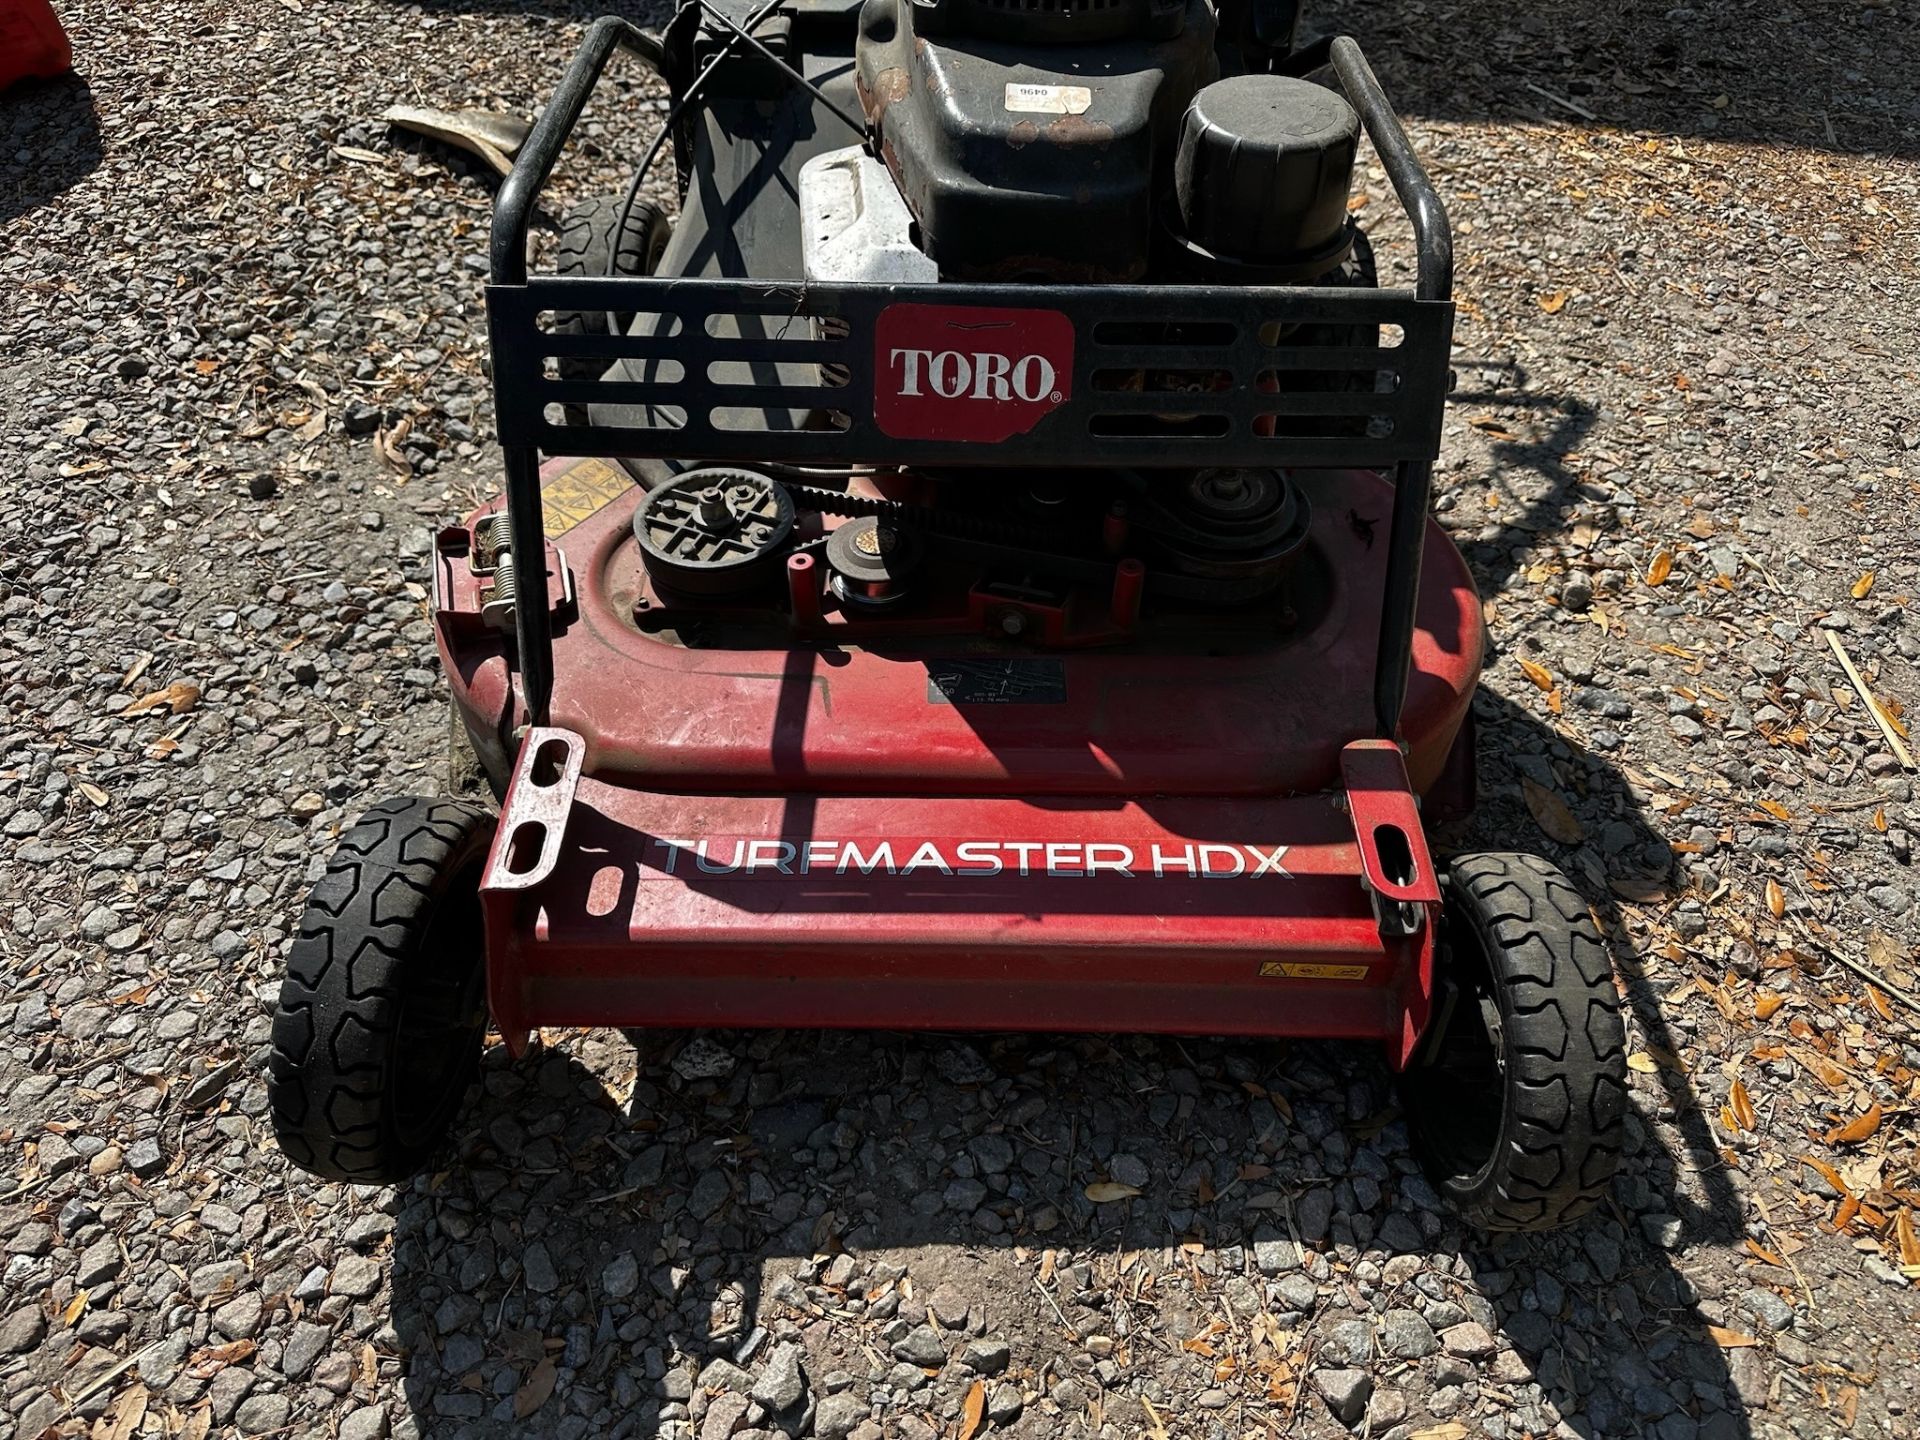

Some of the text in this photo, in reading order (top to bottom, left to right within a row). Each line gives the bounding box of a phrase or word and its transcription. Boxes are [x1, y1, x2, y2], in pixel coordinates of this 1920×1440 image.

[1020, 88, 1048, 96] 0496
[890, 348, 1056, 402] TORO
[654, 839, 1295, 880] TURFMASTER HDX
